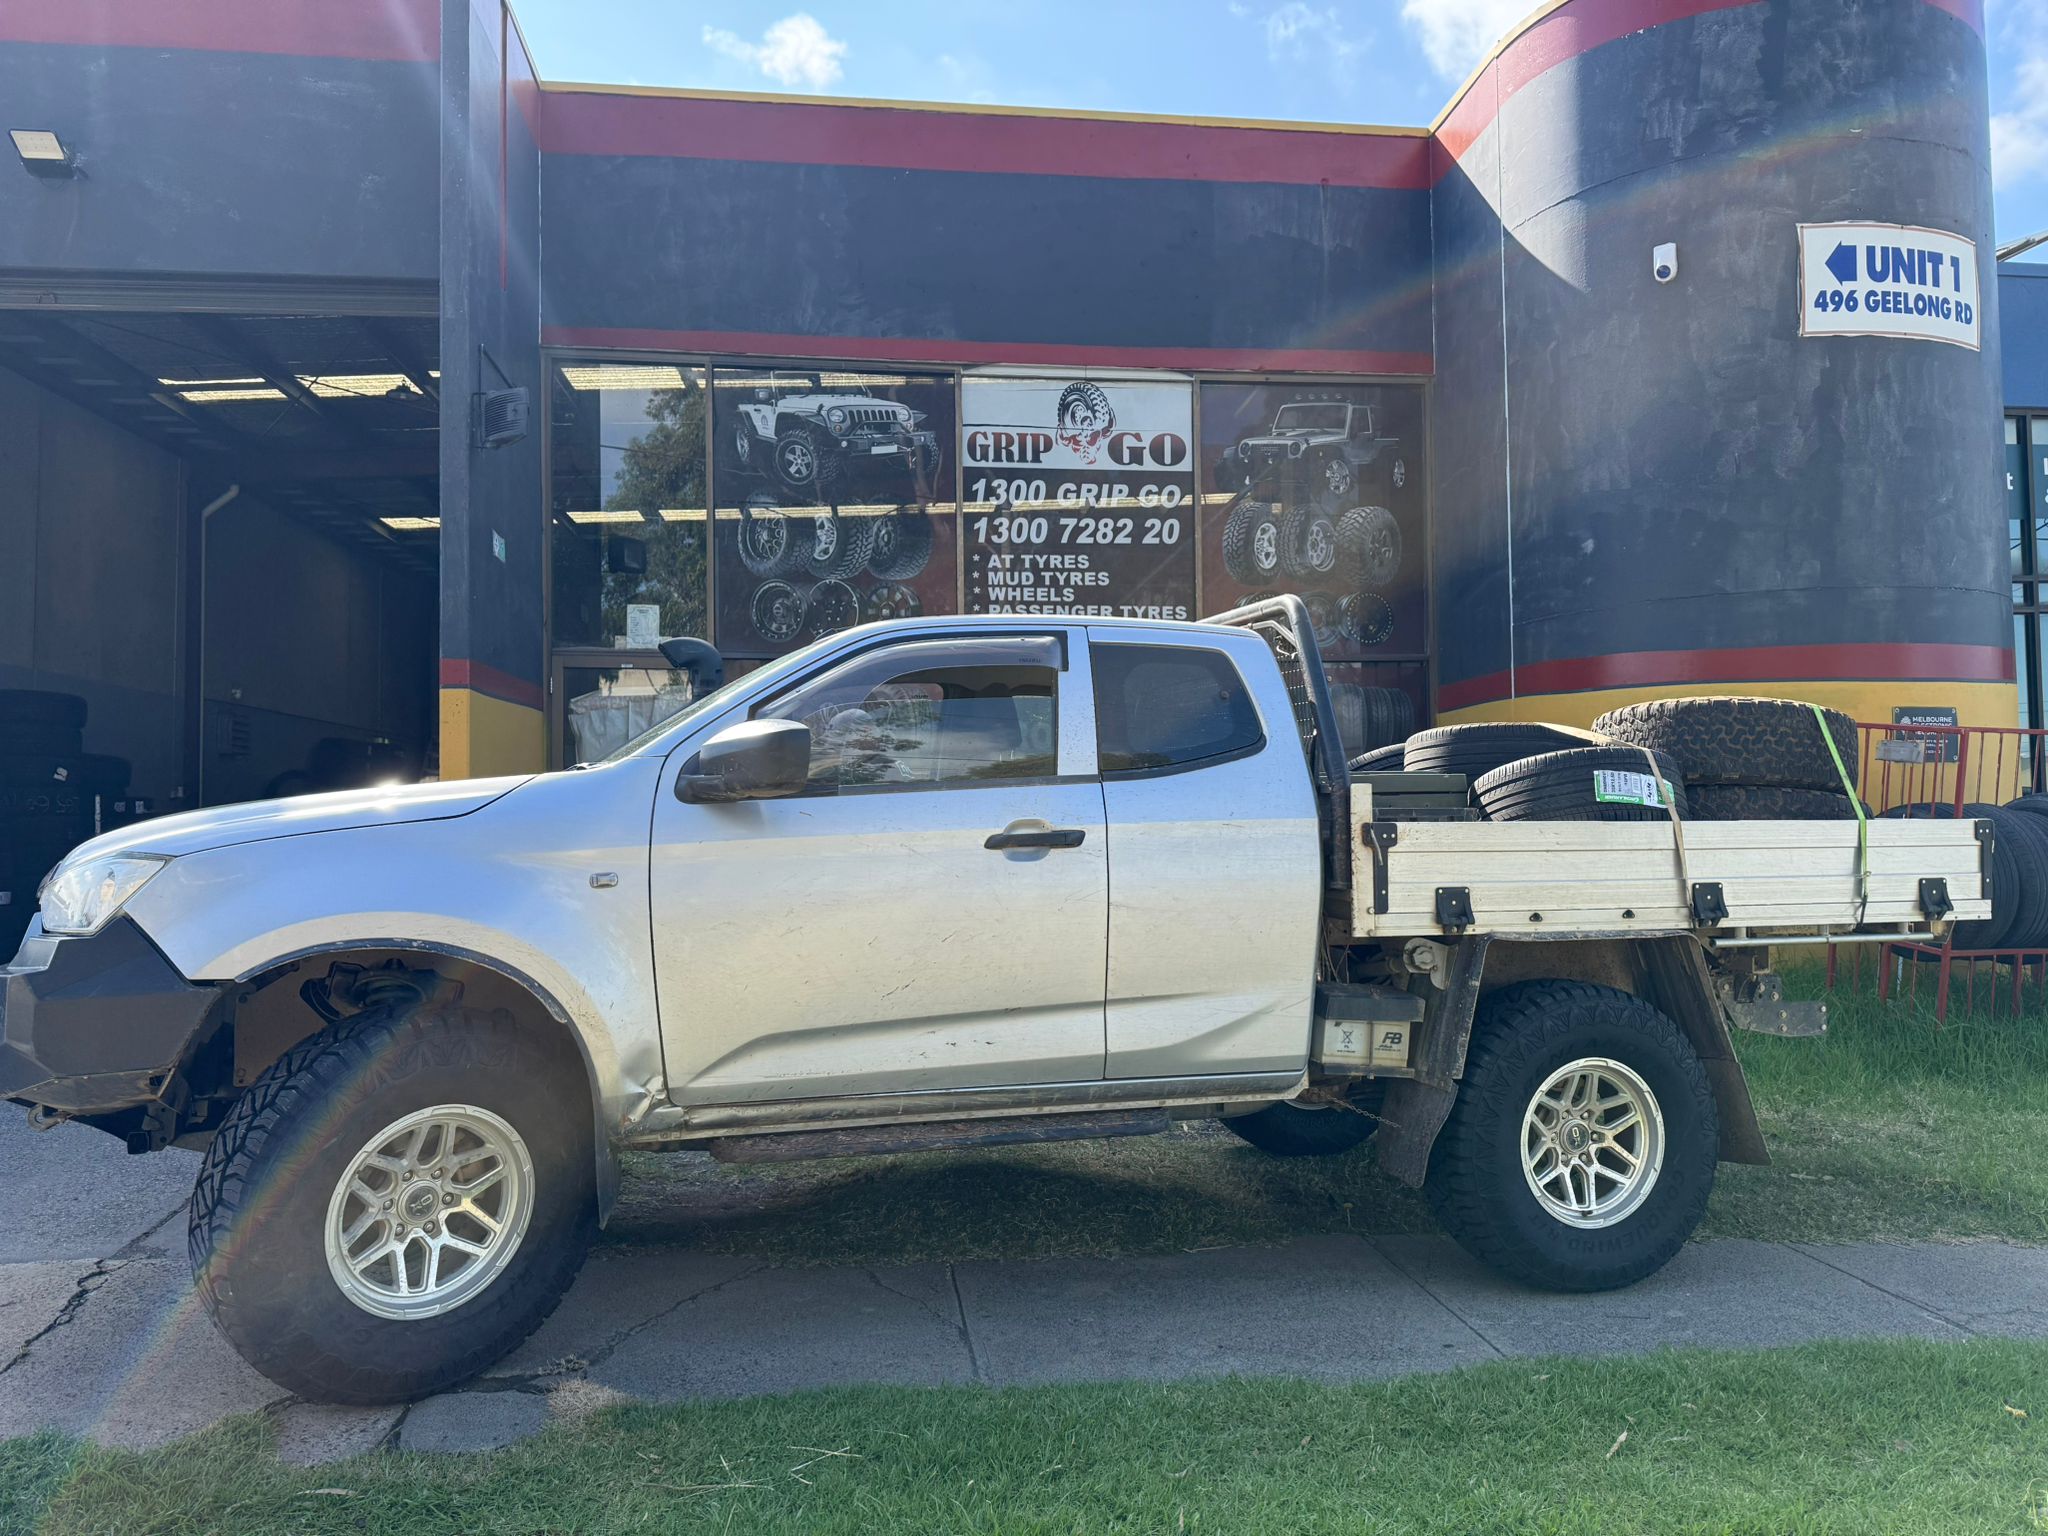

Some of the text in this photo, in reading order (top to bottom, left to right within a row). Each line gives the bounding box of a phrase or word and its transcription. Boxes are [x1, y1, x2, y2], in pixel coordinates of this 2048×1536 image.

[1865, 245, 1961, 293] UNIT 1
[1813, 289, 1973, 325] 496 GEELONG RD
[966, 431, 1187, 467] GRIP GO
[971, 478, 1182, 508] 1300 GRIP GO
[973, 516, 1180, 545] 1300 7282 20
[987, 554, 1090, 569] AT TYRES
[987, 571, 1110, 586] MUD TYRES
[988, 587, 1075, 602] WHEELS
[988, 604, 1188, 620] PASSENGER TYRES
[1382, 1032, 1403, 1045] FB
